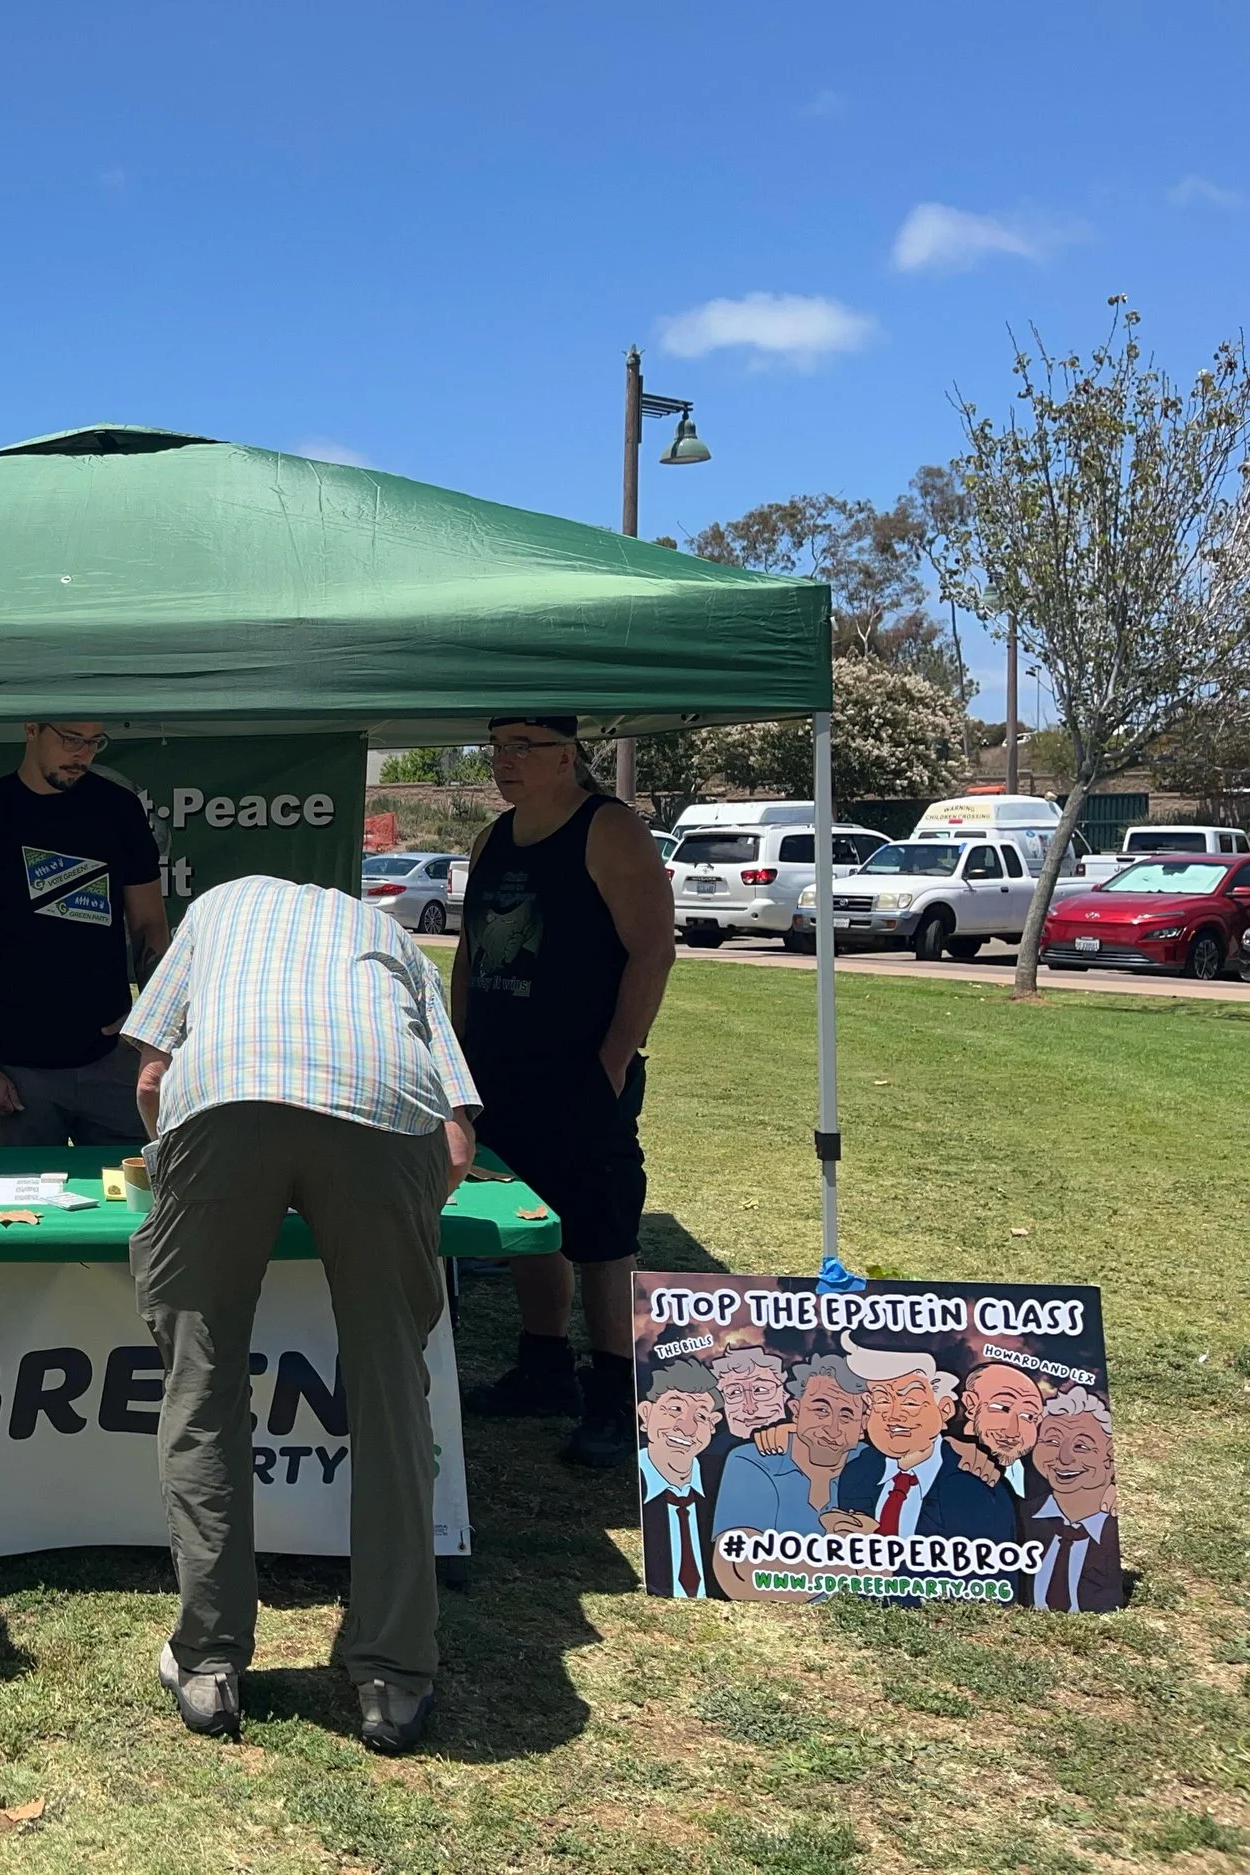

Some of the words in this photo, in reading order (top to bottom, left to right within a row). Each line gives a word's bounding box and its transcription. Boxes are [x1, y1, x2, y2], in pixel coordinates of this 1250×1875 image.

[943, 804, 975, 813] WARNING
[925, 813, 957, 821] CHILDREN
[47, 876, 63, 887] VOTE
[69, 910, 92, 919] GREEN
[652, 1292, 738, 1322] STOP
[749, 1294, 816, 1327] THE
[977, 1299, 1085, 1335] CLASS
[656, 1343, 681, 1359] THE
[984, 1345, 1039, 1370] HOWARD
[1040, 1361, 1069, 1376] AND
[1070, 1367, 1096, 1385] LEX
[253, 1446, 349, 1485] RTY
[722, 1533, 1043, 1573] #NOCREEPERBROS
